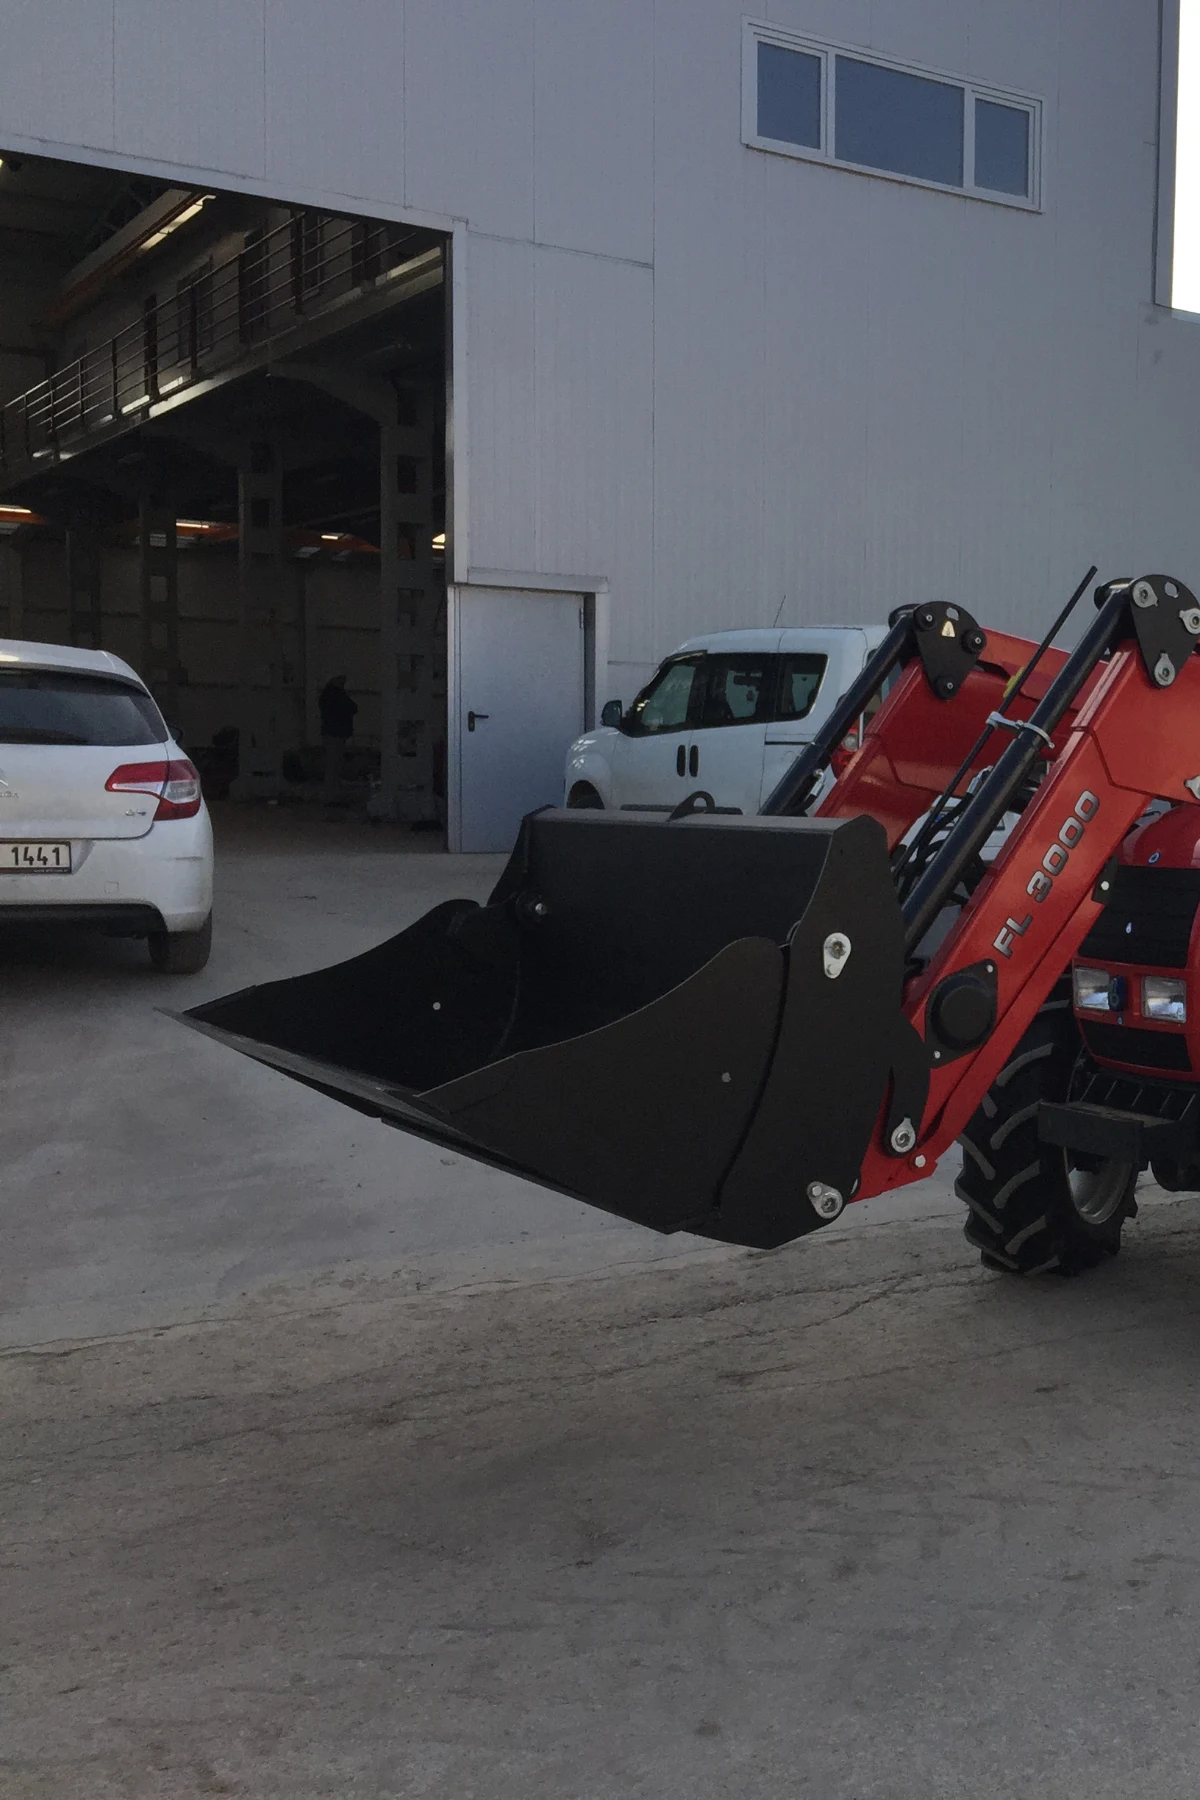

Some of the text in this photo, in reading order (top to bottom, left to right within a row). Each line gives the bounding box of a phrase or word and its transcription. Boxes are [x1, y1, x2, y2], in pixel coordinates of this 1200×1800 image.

[11, 846, 60, 866] 1441
[992, 789, 1101, 959] FL 3000
